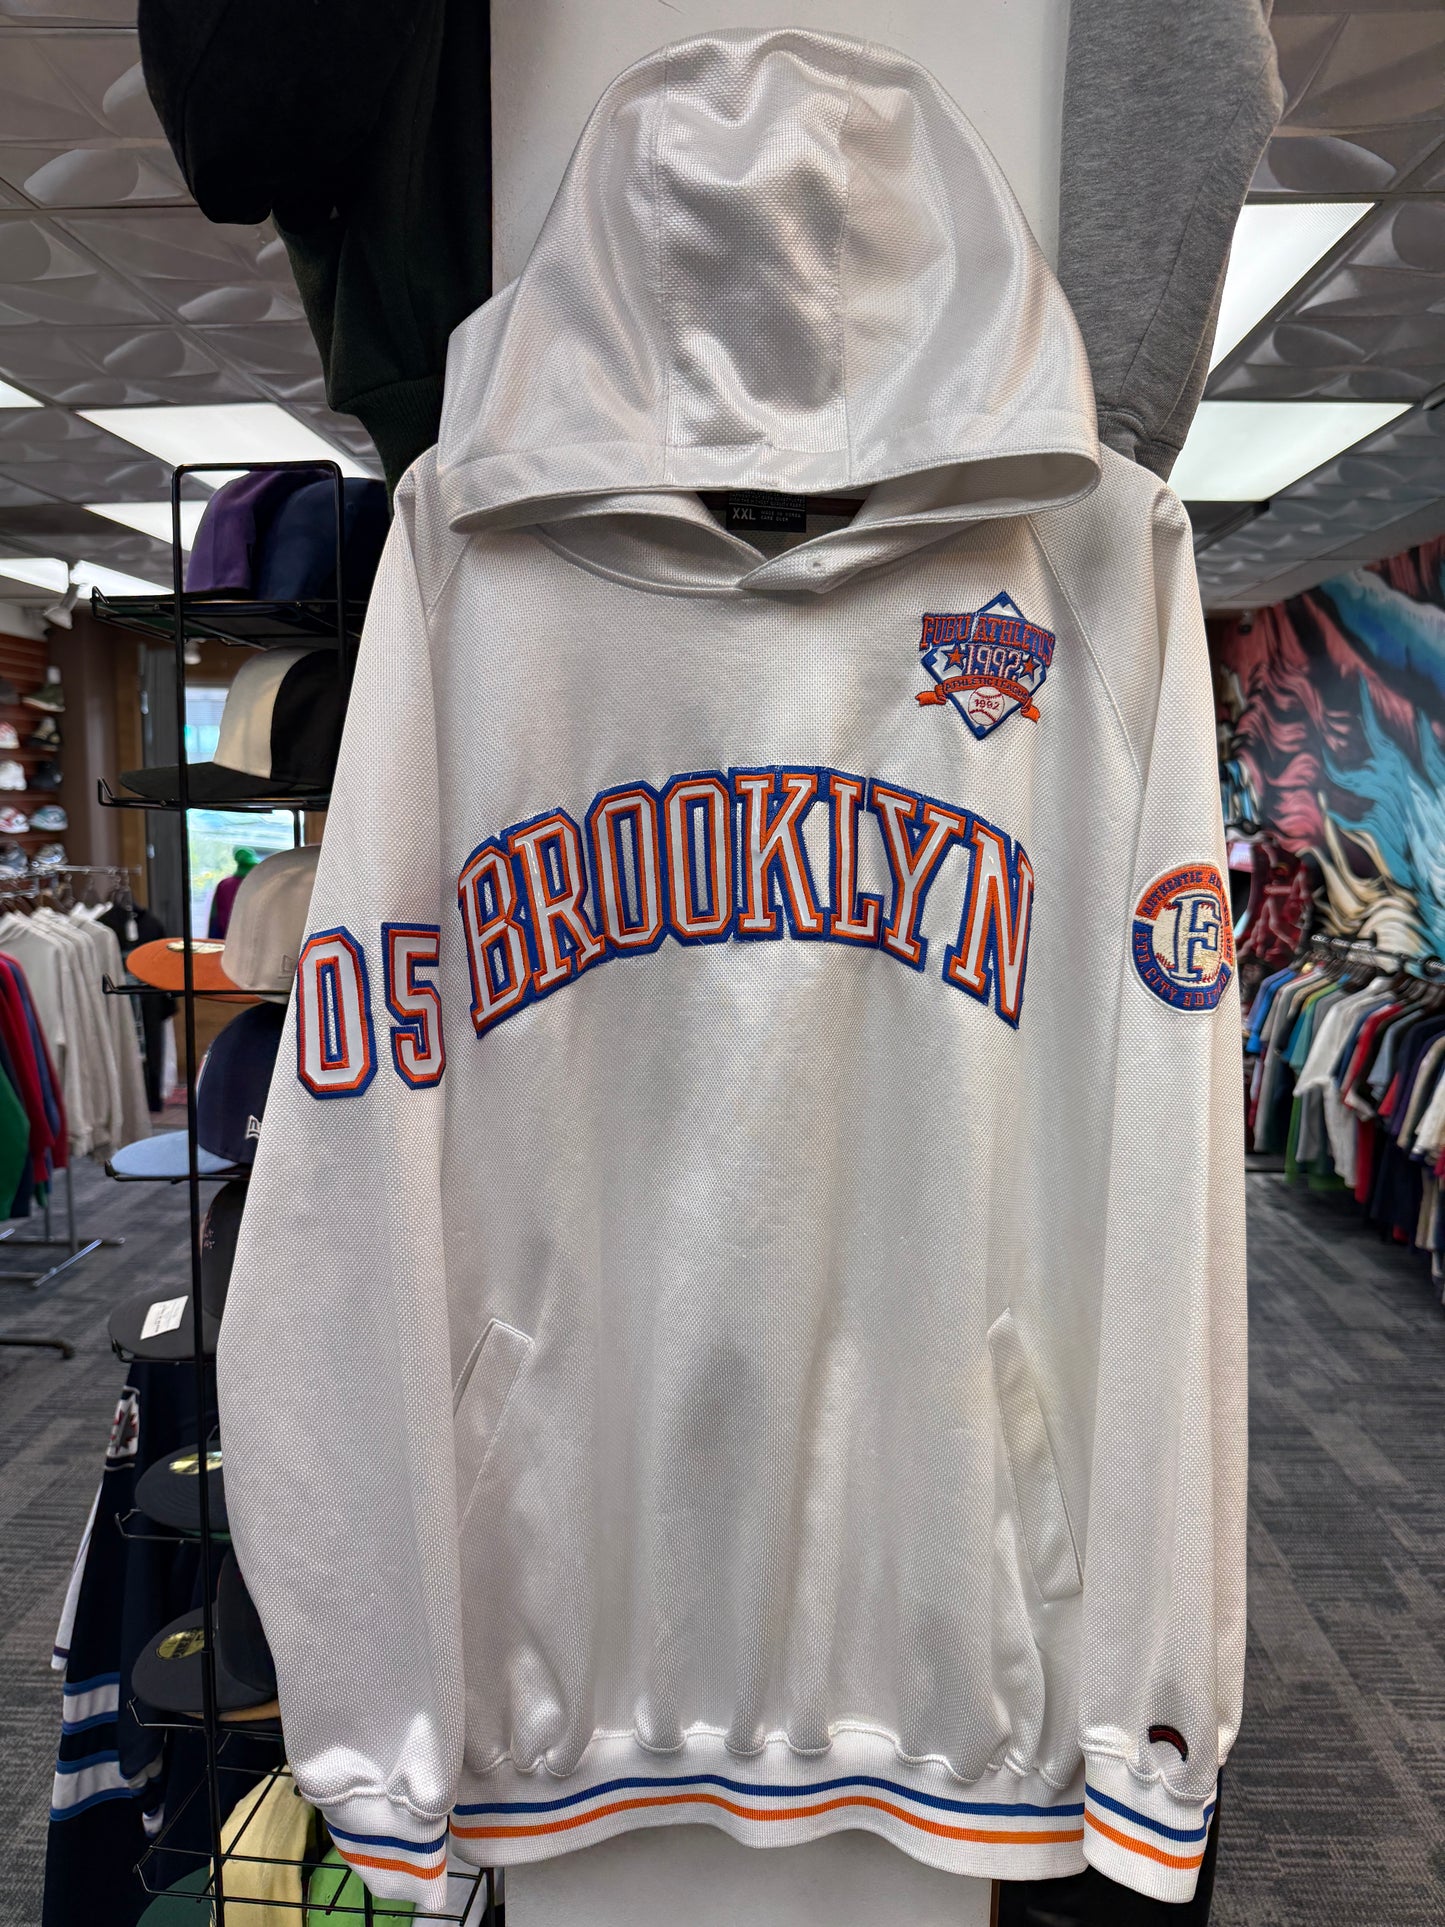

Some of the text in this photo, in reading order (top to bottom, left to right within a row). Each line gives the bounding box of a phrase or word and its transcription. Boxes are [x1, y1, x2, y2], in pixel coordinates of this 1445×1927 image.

[732, 507, 756, 521] XXL
[920, 615, 1055, 666] FUBU ATHLETICS
[966, 644, 1022, 681] 1992
[945, 677, 992, 692] ATHLETIC
[974, 698, 1001, 710] 1992
[457, 765, 1034, 1039] BROOKLYN
[1141, 870, 1203, 916] AUTHENTIC
[1144, 967, 1178, 1001] CITY
[296, 921, 447, 1100] 05
